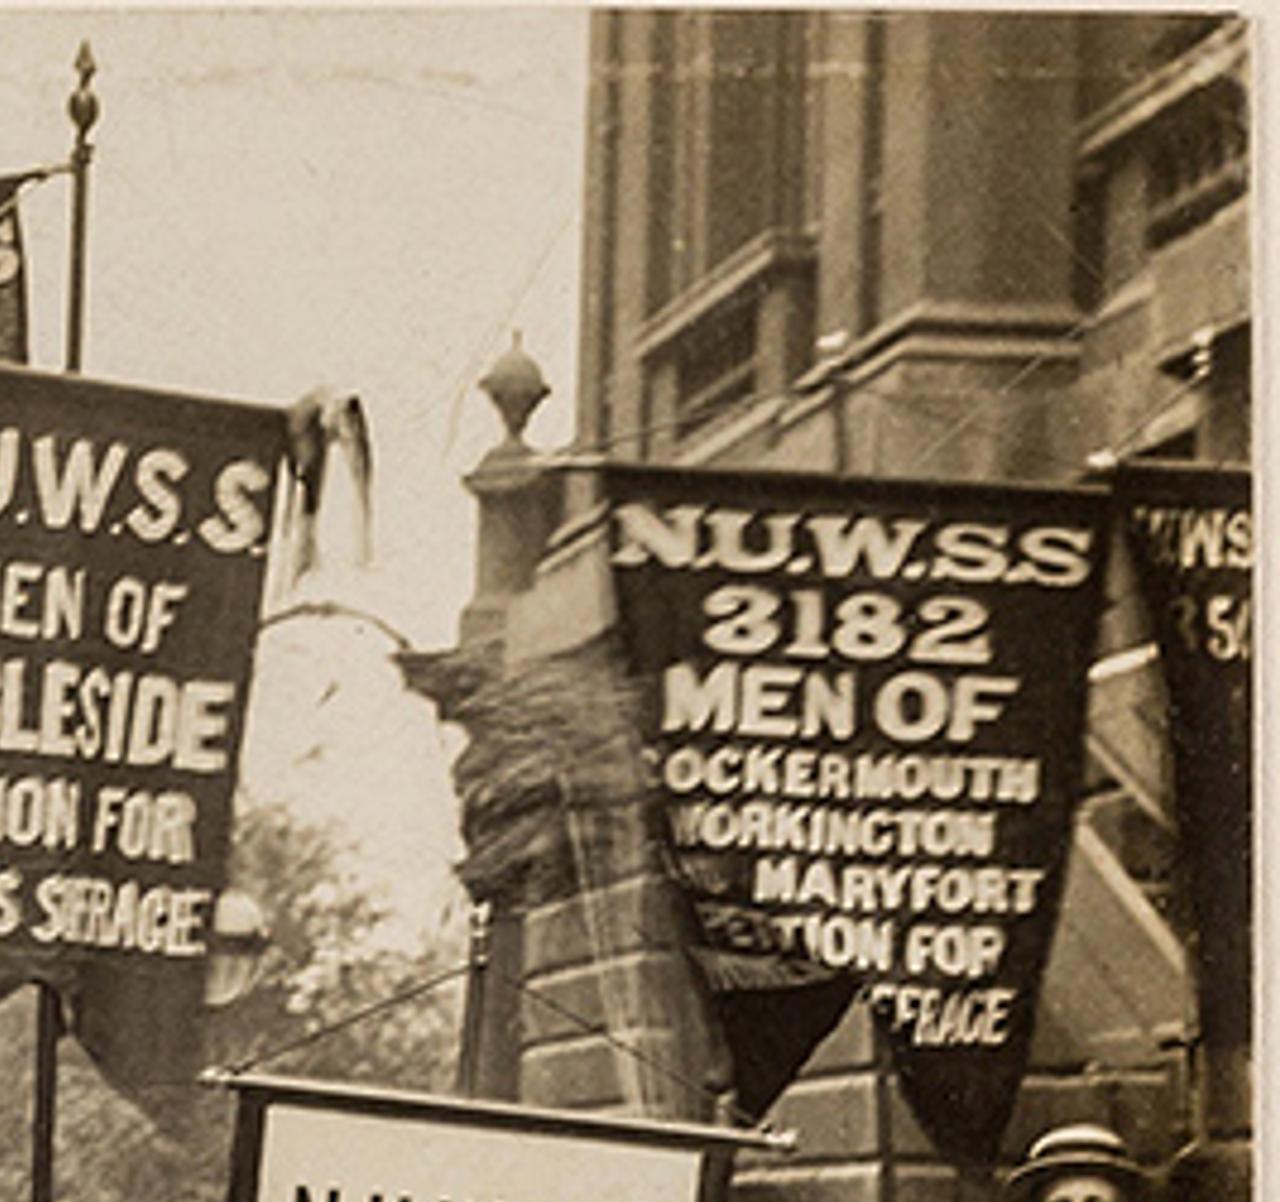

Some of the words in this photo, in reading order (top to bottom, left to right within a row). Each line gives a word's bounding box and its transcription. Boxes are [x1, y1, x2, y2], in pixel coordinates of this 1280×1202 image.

[105, 578, 188, 653] OF
[703, 585, 993, 664] 3182
[661, 662, 857, 740] MEN
[874, 671, 1021, 743] OF
[94, 786, 197, 863] FOR
